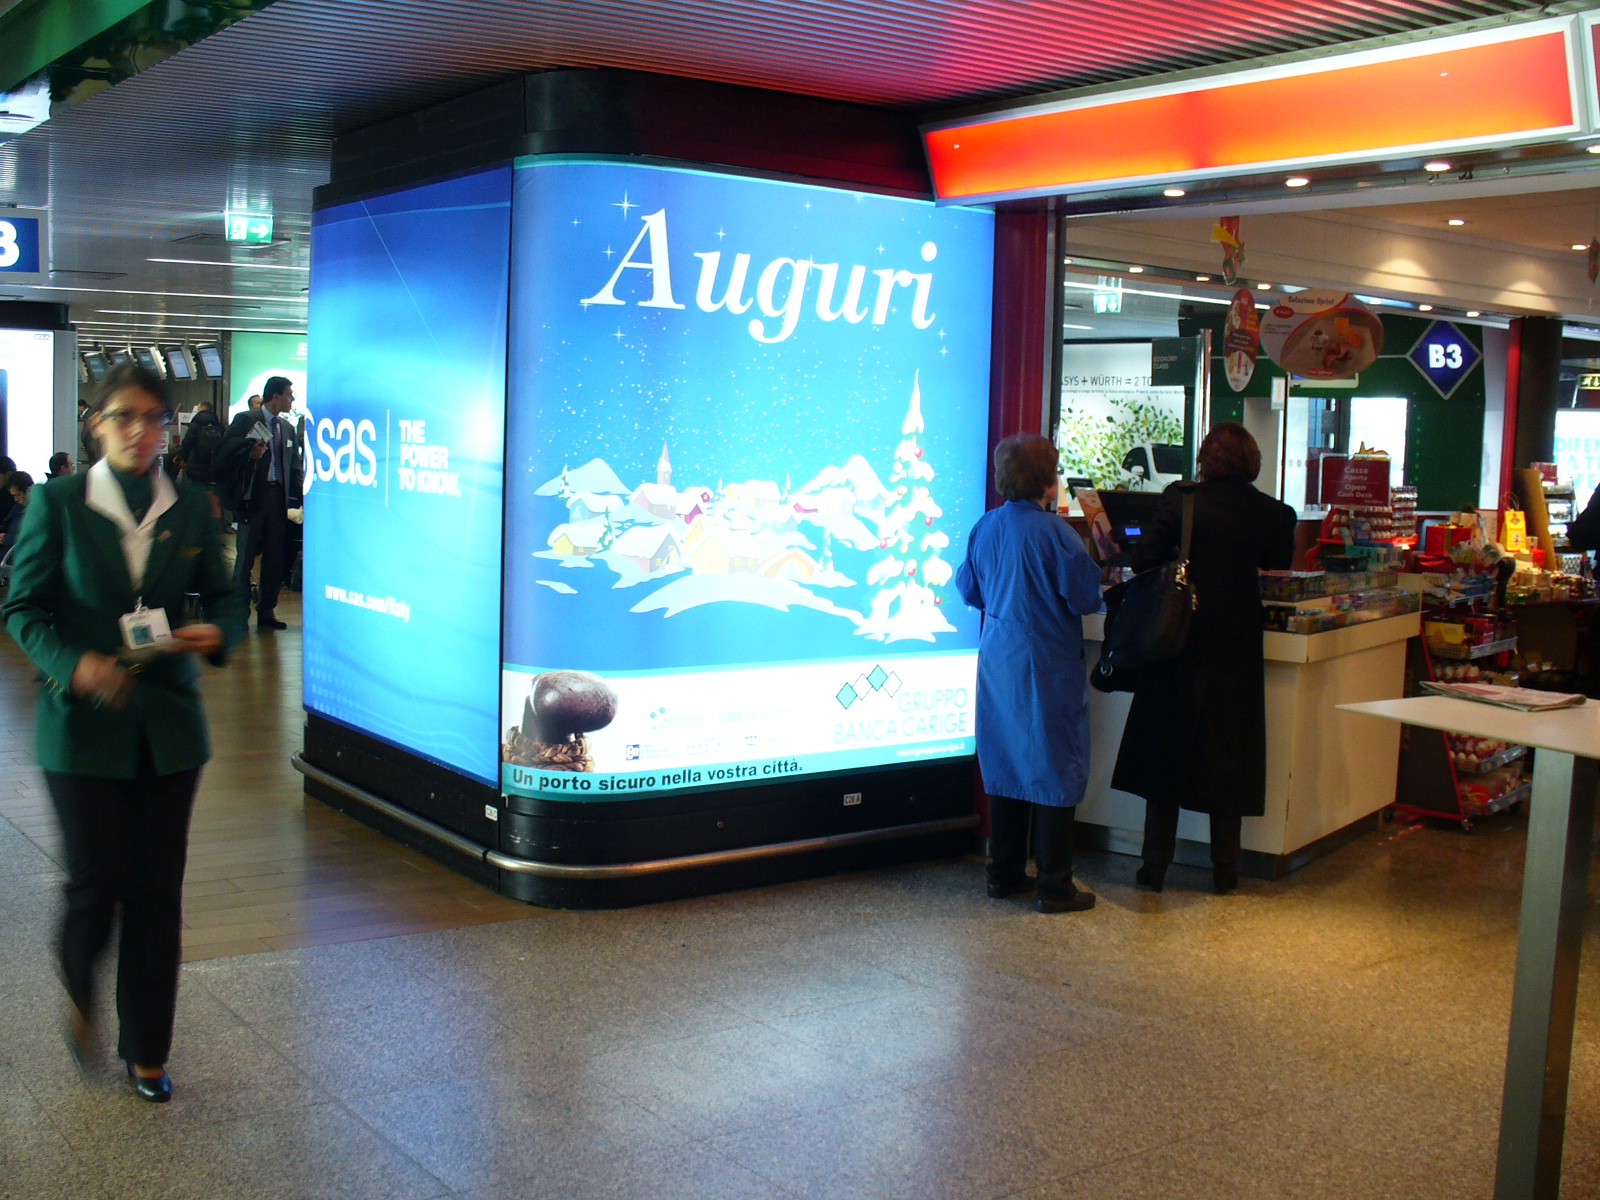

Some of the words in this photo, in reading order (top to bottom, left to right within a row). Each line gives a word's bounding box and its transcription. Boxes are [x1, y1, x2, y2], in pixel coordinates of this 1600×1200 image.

[580, 208, 937, 343] Auguri
[1429, 344, 1463, 369] B3
[1062, 376, 1079, 386] SYS
[1090, 374, 1122, 386] WÜRTH
[1134, 377, 1139, 386] 2
[399, 420, 425, 443] THE
[400, 444, 448, 469] POWER
[398, 468, 416, 490] TO
[1344, 466, 1368, 474] Cassa
[1345, 483, 1366, 492] Open
[897, 688, 968, 712] GRUPPO
[834, 719, 898, 744] BANCA
[903, 712, 967, 737] CARIGE
[513, 768, 533, 787] Un
[539, 777, 591, 791] porto
[598, 773, 656, 791] sicuro
[661, 769, 702, 786] nella
[707, 764, 757, 781] vostra
[762, 759, 803, 775] città.
